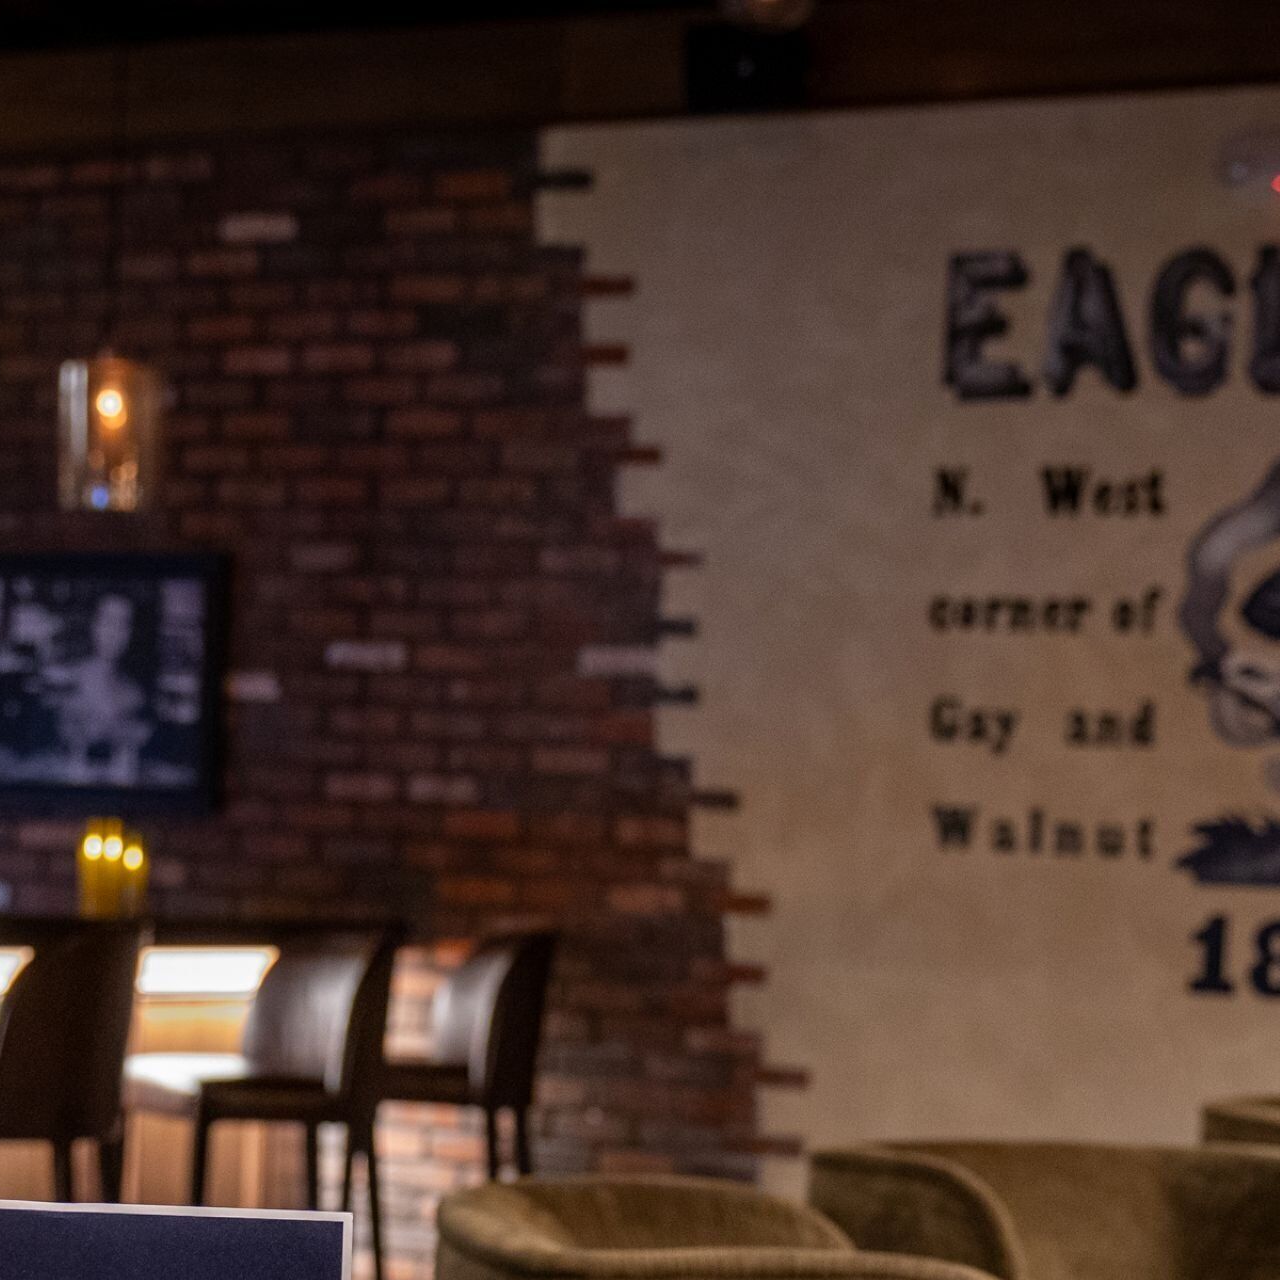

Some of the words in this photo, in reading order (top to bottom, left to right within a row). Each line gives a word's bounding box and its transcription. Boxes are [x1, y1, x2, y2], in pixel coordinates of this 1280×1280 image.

[930, 462, 984, 520] N.
[1039, 463, 1167, 518] West
[928, 594, 1090, 635] corner
[1112, 582, 1164, 636] of
[929, 697, 1016, 756] Gay
[1064, 701, 1154, 748] and
[932, 805, 1154, 861] Walnut
